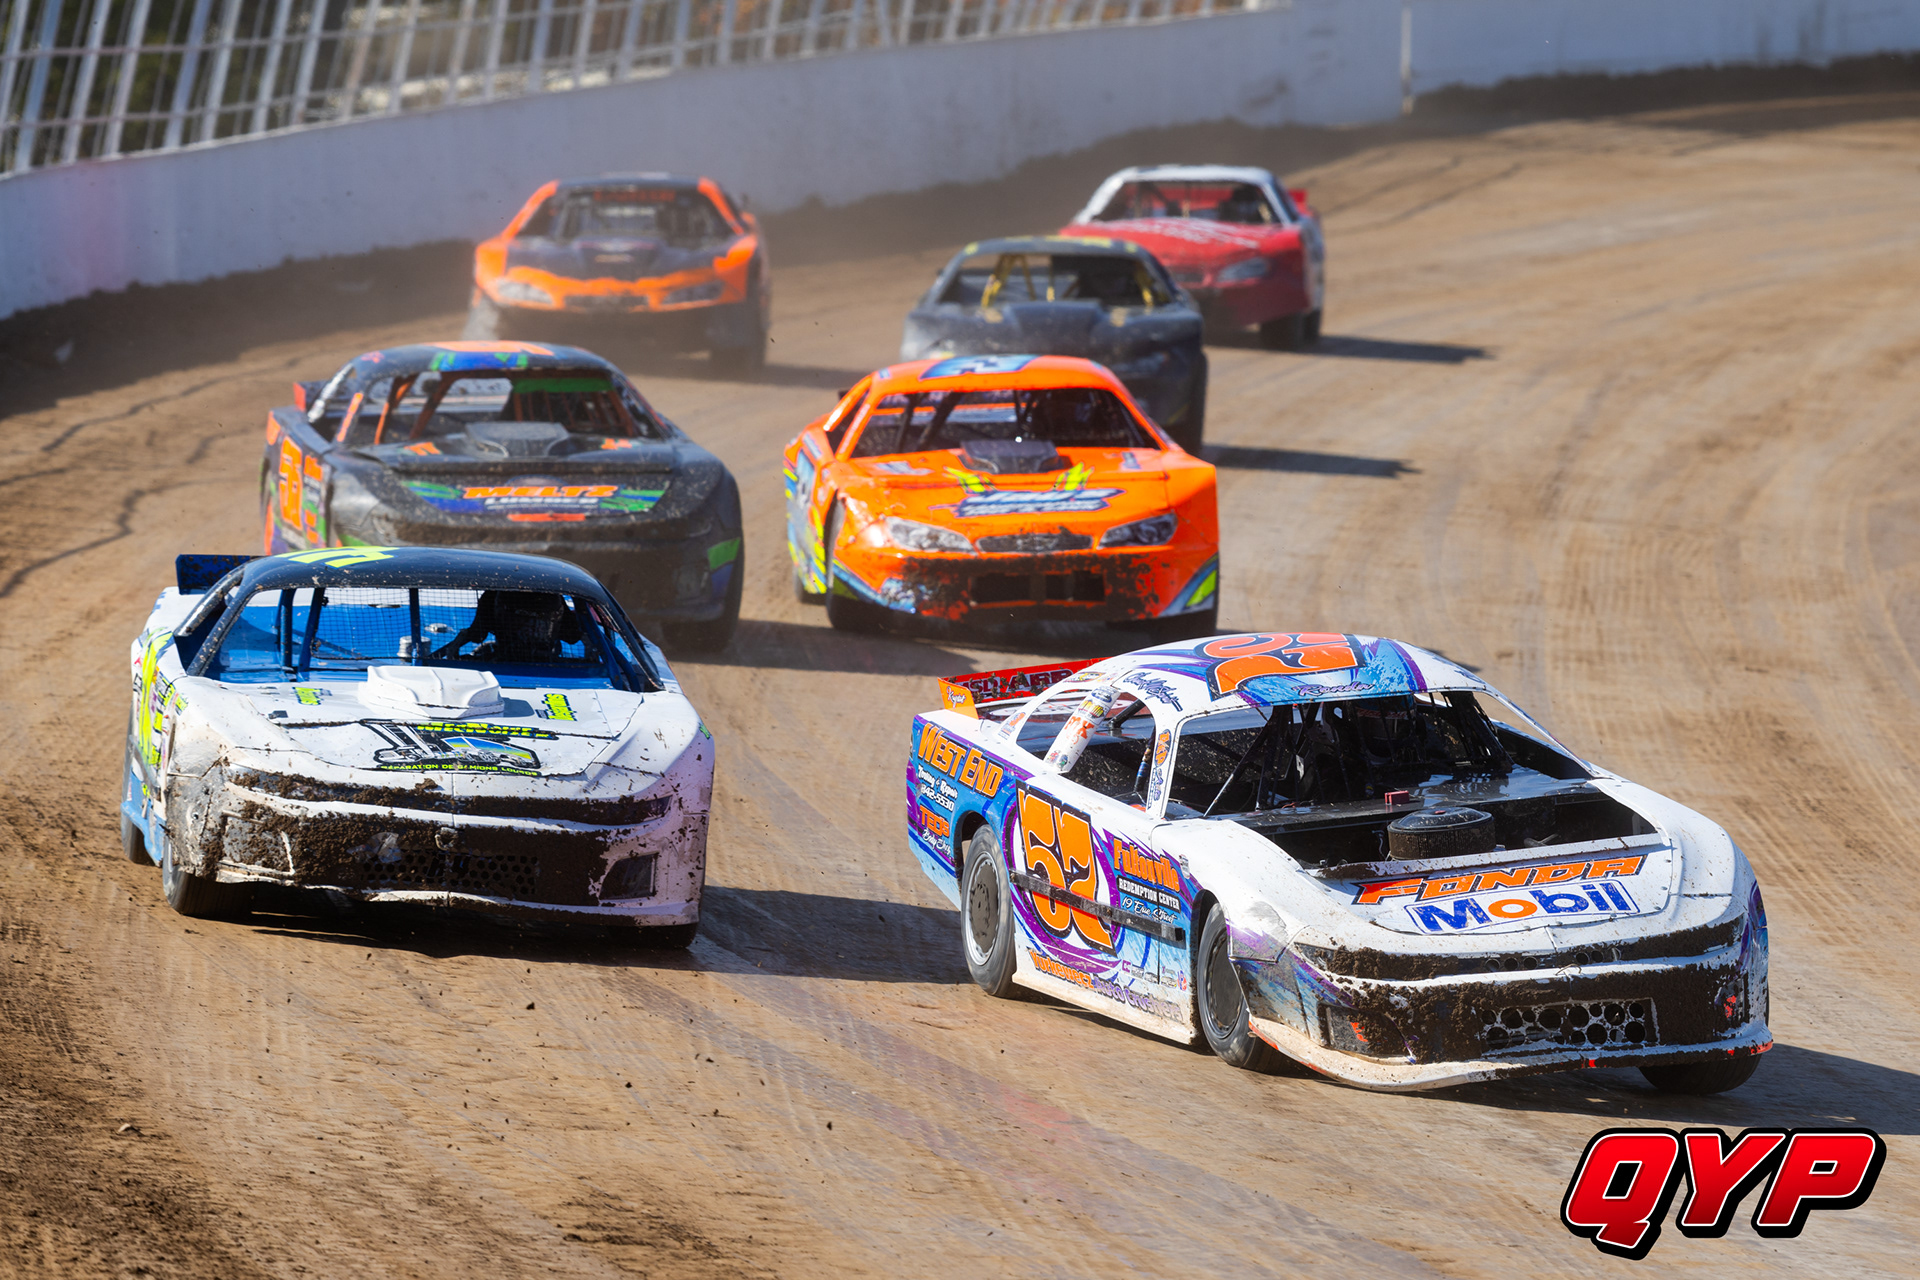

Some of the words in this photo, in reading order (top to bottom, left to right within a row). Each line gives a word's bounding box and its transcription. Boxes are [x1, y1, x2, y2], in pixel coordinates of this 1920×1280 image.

[463, 485, 619, 499] MELTZ
[918, 721, 968, 779] WEST
[957, 747, 1005, 799] END
[1017, 786, 1116, 953] 57
[1112, 836, 1181, 894] Fultonville
[1351, 855, 1647, 905] FONDA
[1118, 876, 1158, 902] REDEMPTION
[1158, 892, 1181, 912] CENTER
[1121, 896, 1134, 910] 19
[1415, 881, 1632, 933] Mobil
[1094, 974, 1126, 1004] Auto
